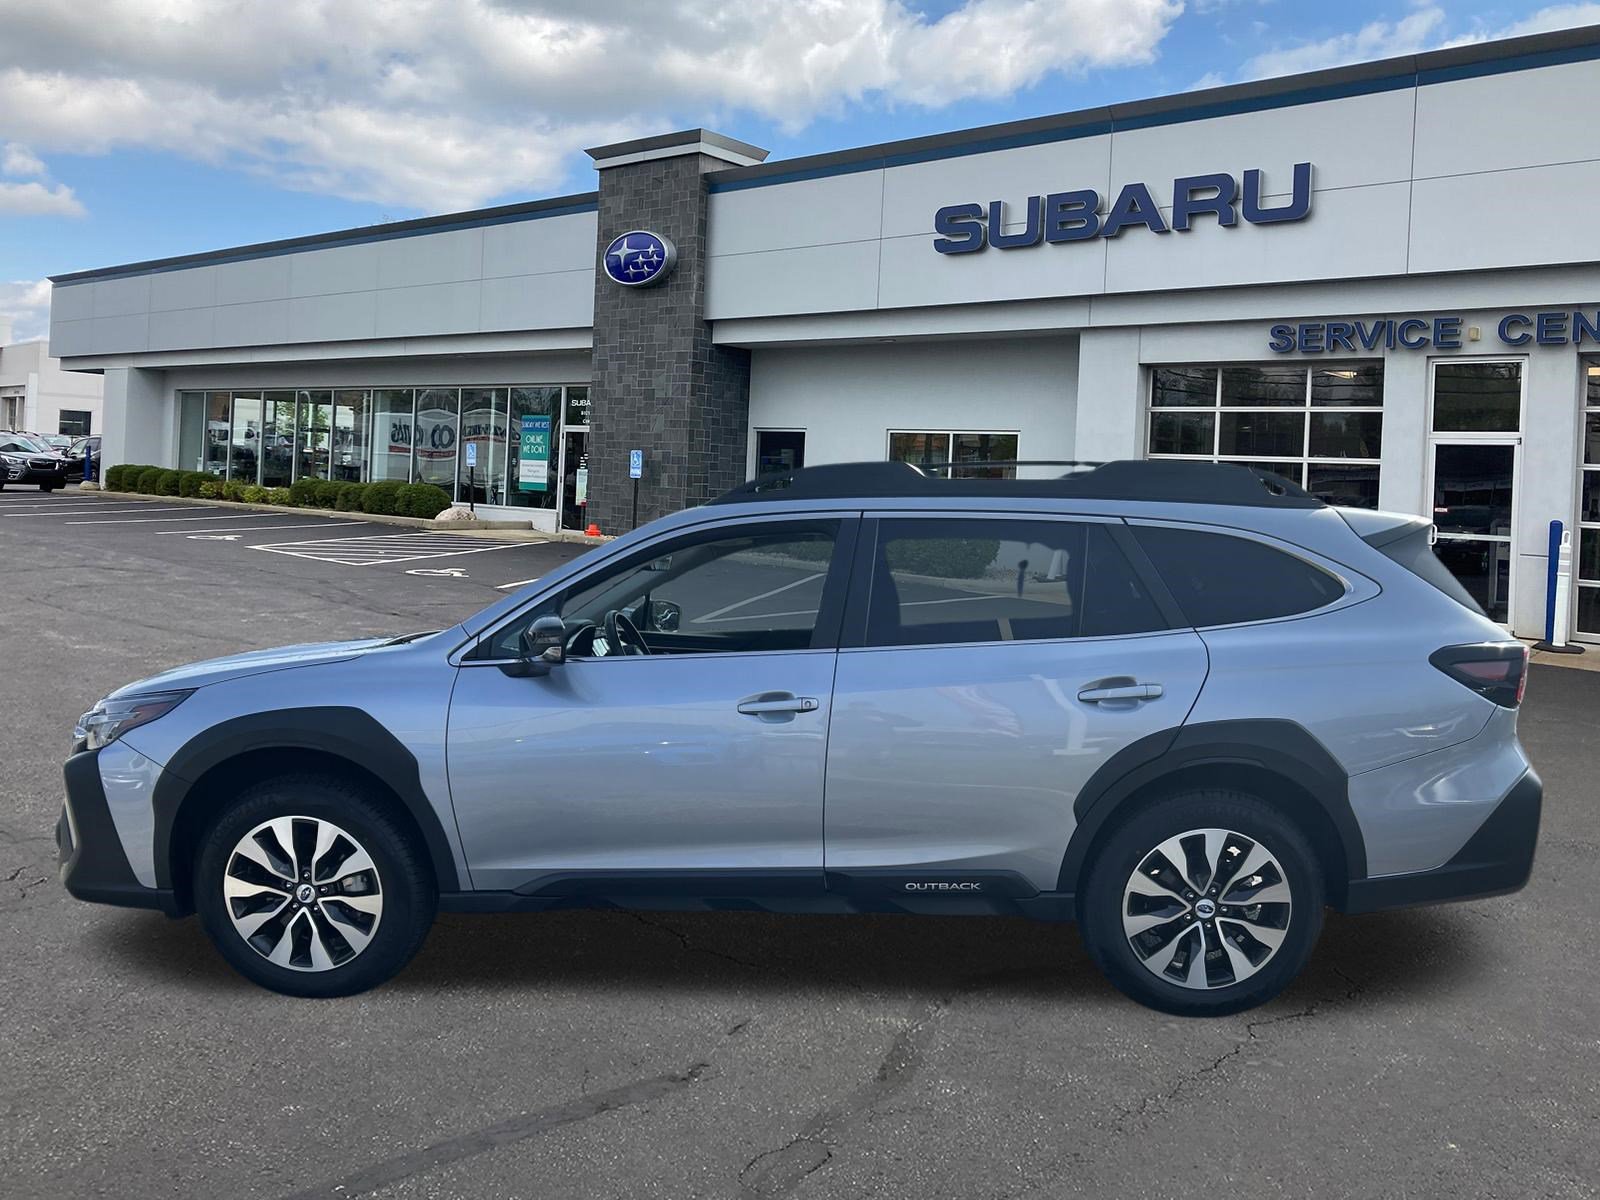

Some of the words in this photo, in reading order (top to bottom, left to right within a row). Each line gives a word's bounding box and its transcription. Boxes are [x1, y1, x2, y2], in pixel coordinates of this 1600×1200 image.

[934, 162, 1313, 255] SUBARU
[1269, 317, 1463, 353] SERVICE
[1498, 311, 1600, 346] CEN
[905, 882, 981, 890] OUTBACK
